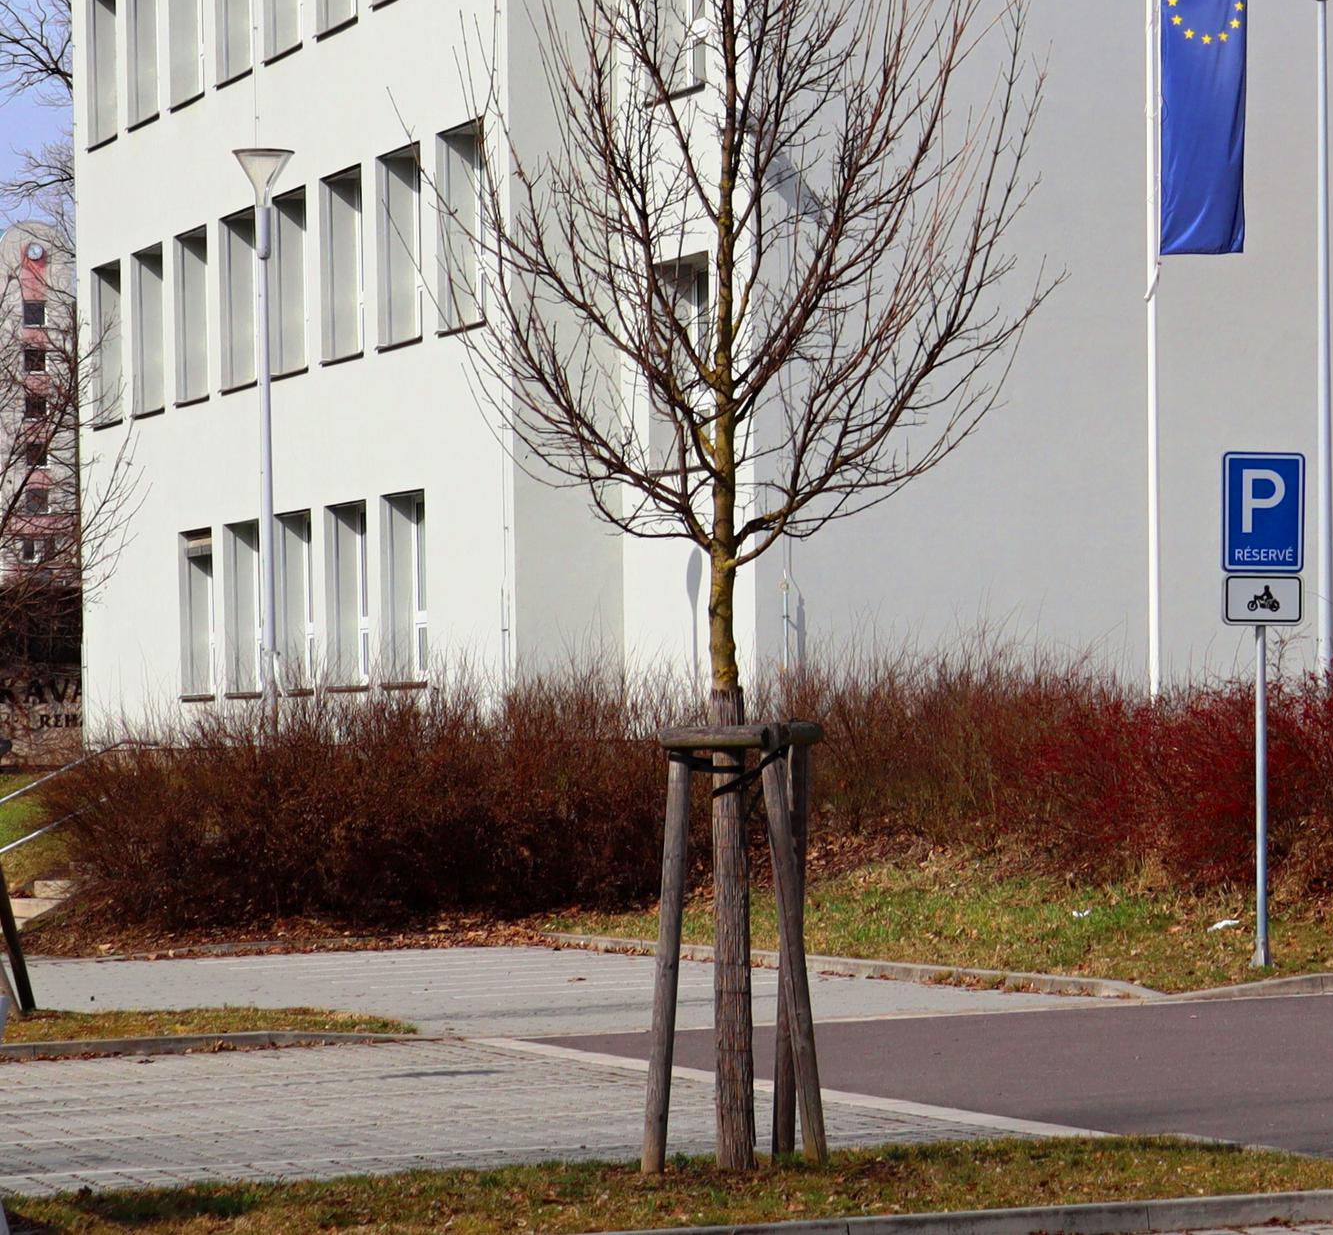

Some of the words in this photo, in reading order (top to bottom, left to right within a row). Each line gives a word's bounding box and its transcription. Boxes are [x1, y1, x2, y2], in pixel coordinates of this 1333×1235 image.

[1242, 468, 1286, 533] P
[1235, 545, 1293, 561] RÉSERVÉ
[40, 714, 82, 728] REH
